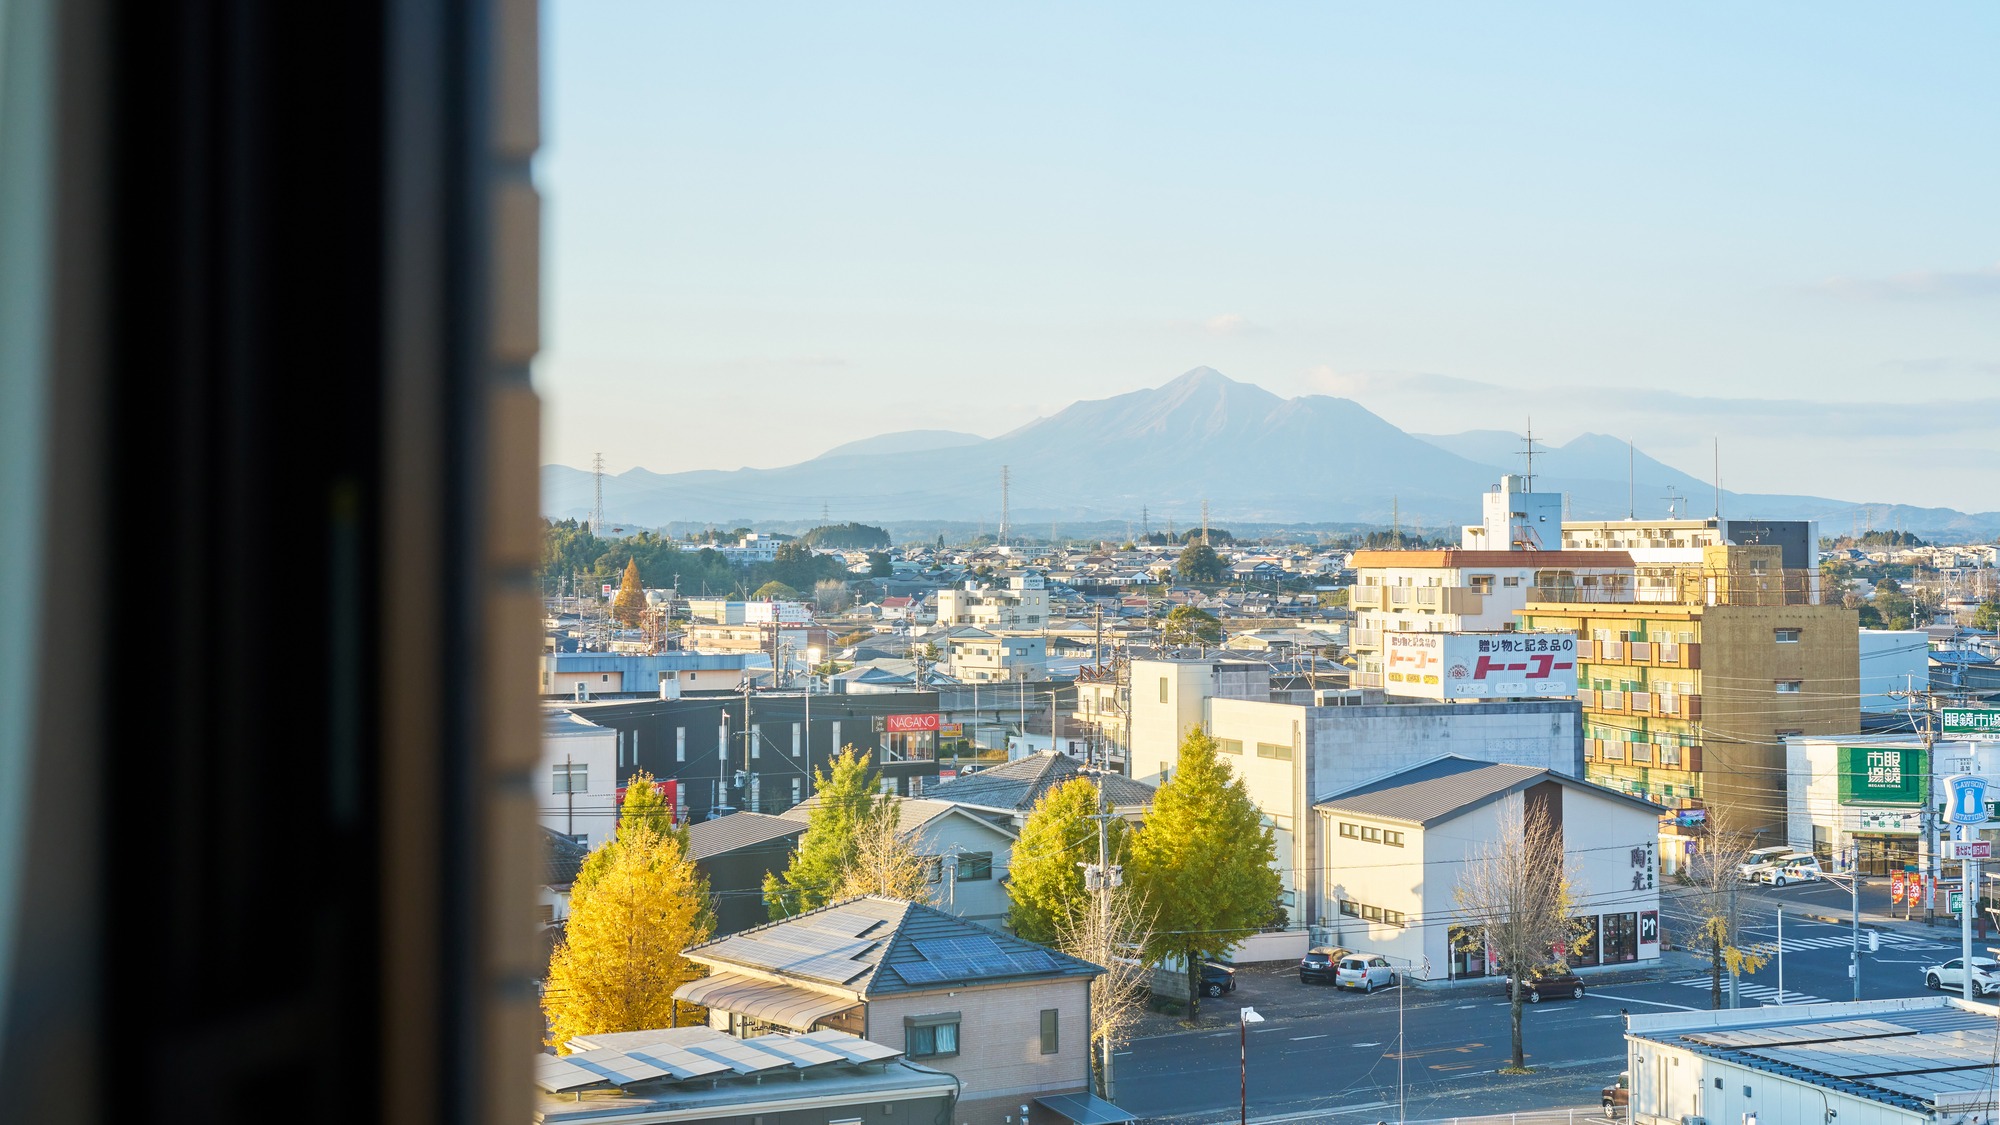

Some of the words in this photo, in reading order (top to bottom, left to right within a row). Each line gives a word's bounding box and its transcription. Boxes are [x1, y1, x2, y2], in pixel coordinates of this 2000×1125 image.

[1478, 638, 1573, 652] 贈り物と記念品の
[1389, 649, 1439, 669] トーコー
[1473, 654, 1573, 680] トーコー
[890, 715, 936, 729] NAGANO
[1955, 780, 1984, 790] LAWSON
[1954, 812, 1985, 821] STATION
[1630, 846, 1647, 891] 陶光
[1642, 918, 1649, 937] P
